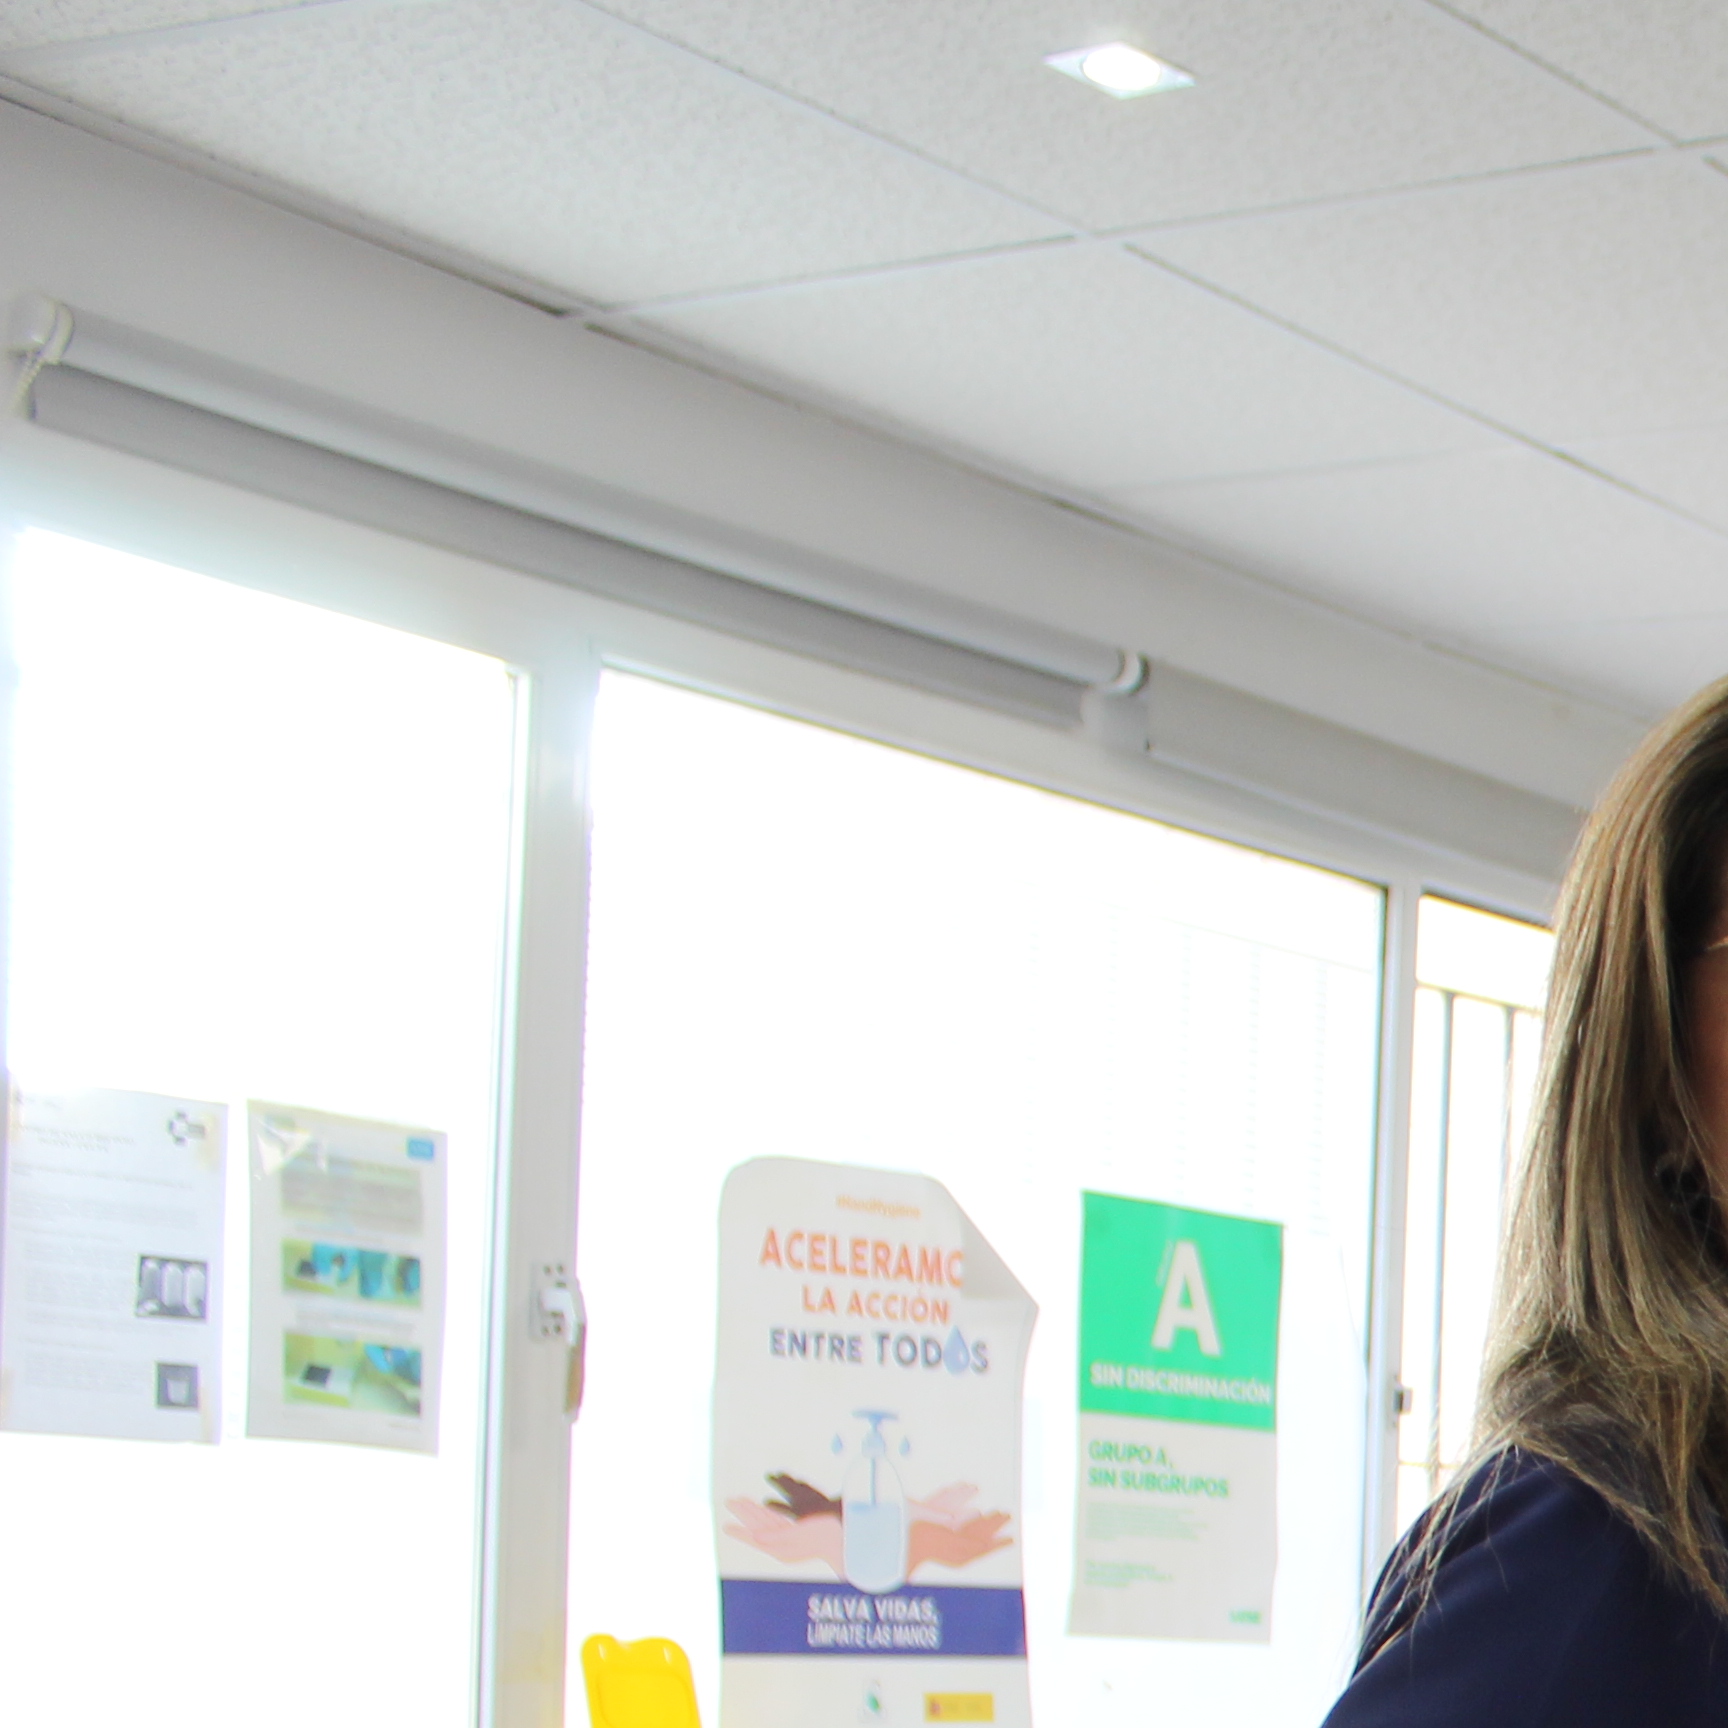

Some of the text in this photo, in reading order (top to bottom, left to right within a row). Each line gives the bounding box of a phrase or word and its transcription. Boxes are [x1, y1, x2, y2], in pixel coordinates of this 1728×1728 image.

[802, 1284, 951, 1325] LA ACCIÓN
[1152, 1240, 1221, 1356] A
[769, 1327, 863, 1364] ENTRE
[1090, 1362, 1272, 1405] SIN DISCRIMINACIÓN
[1089, 1440, 1151, 1465] GRUPO
[1089, 1467, 1230, 1497] SIN SUBGRUPOS
[807, 1593, 872, 1622] SALVA
[866, 1623, 893, 1648] LAS
